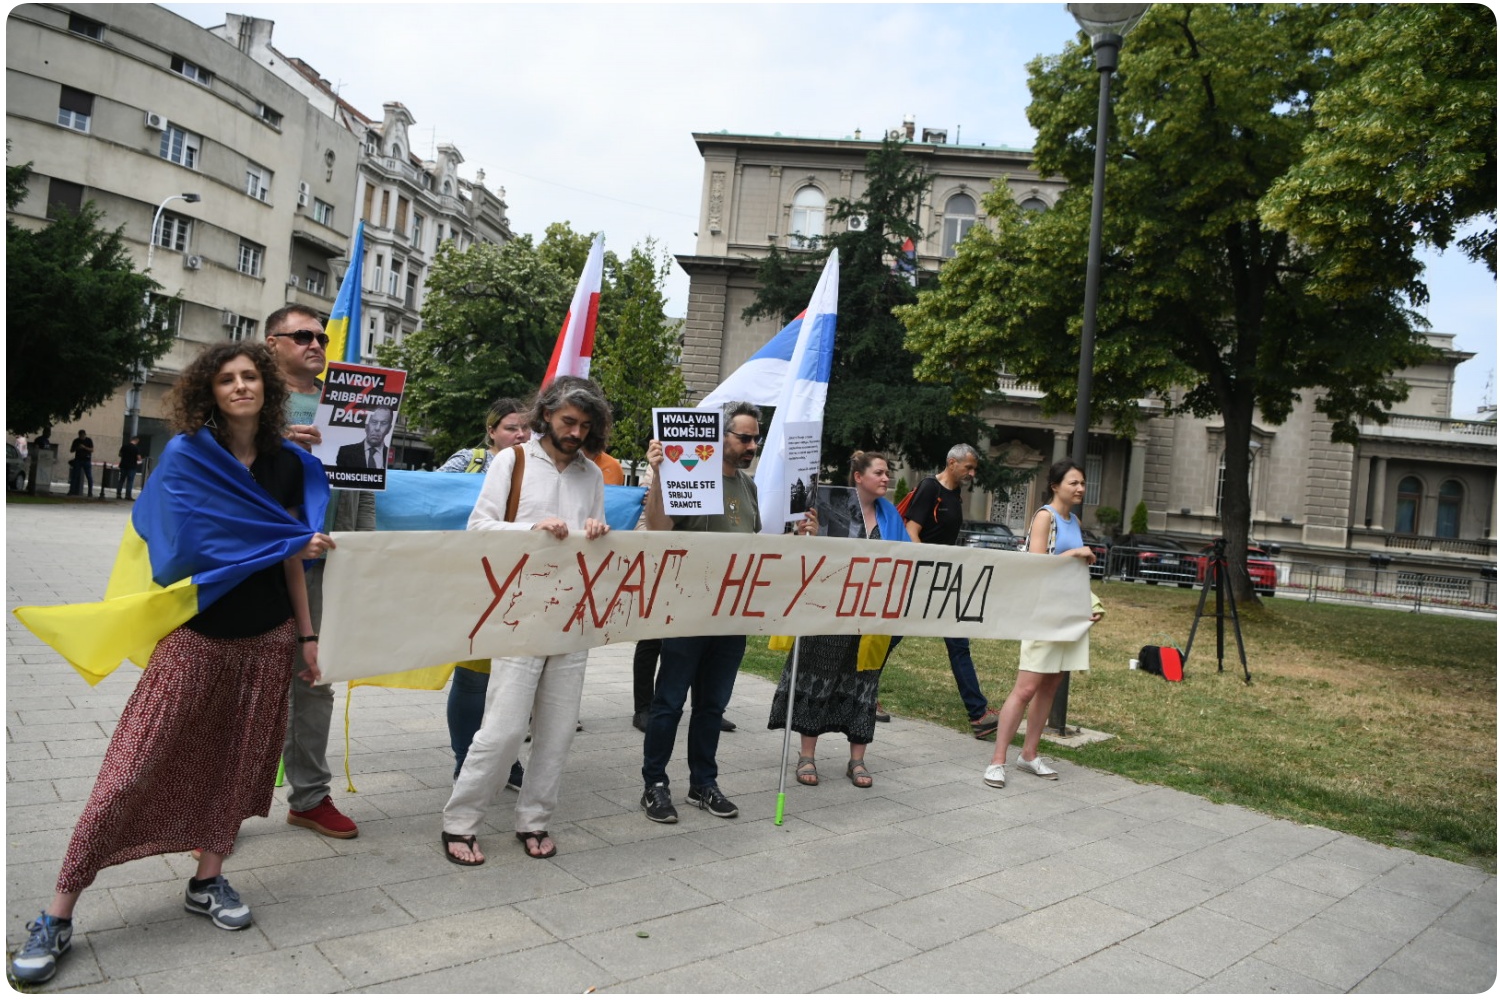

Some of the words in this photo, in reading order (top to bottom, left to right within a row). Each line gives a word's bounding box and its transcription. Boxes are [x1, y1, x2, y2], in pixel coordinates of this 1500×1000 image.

[329, 371, 385, 388] LAVROV-
[325, 390, 399, 407] -RIBBENTROP
[332, 408, 375, 425] PACT
[662, 414, 695, 424] HVALA
[694, 414, 715, 424] VAM
[663, 424, 716, 438] KOMŠIJE!
[335, 472, 383, 483] CONSCIENCE
[666, 480, 699, 489] SPASILE
[699, 480, 716, 489] STE
[668, 491, 693, 499] SRBIJU
[670, 500, 702, 509] SRAMOTE
[468, 552, 531, 640] У
[711, 553, 782, 617] НЕ
[782, 554, 827, 617] У
[835, 556, 994, 624] БЕОГРАД
